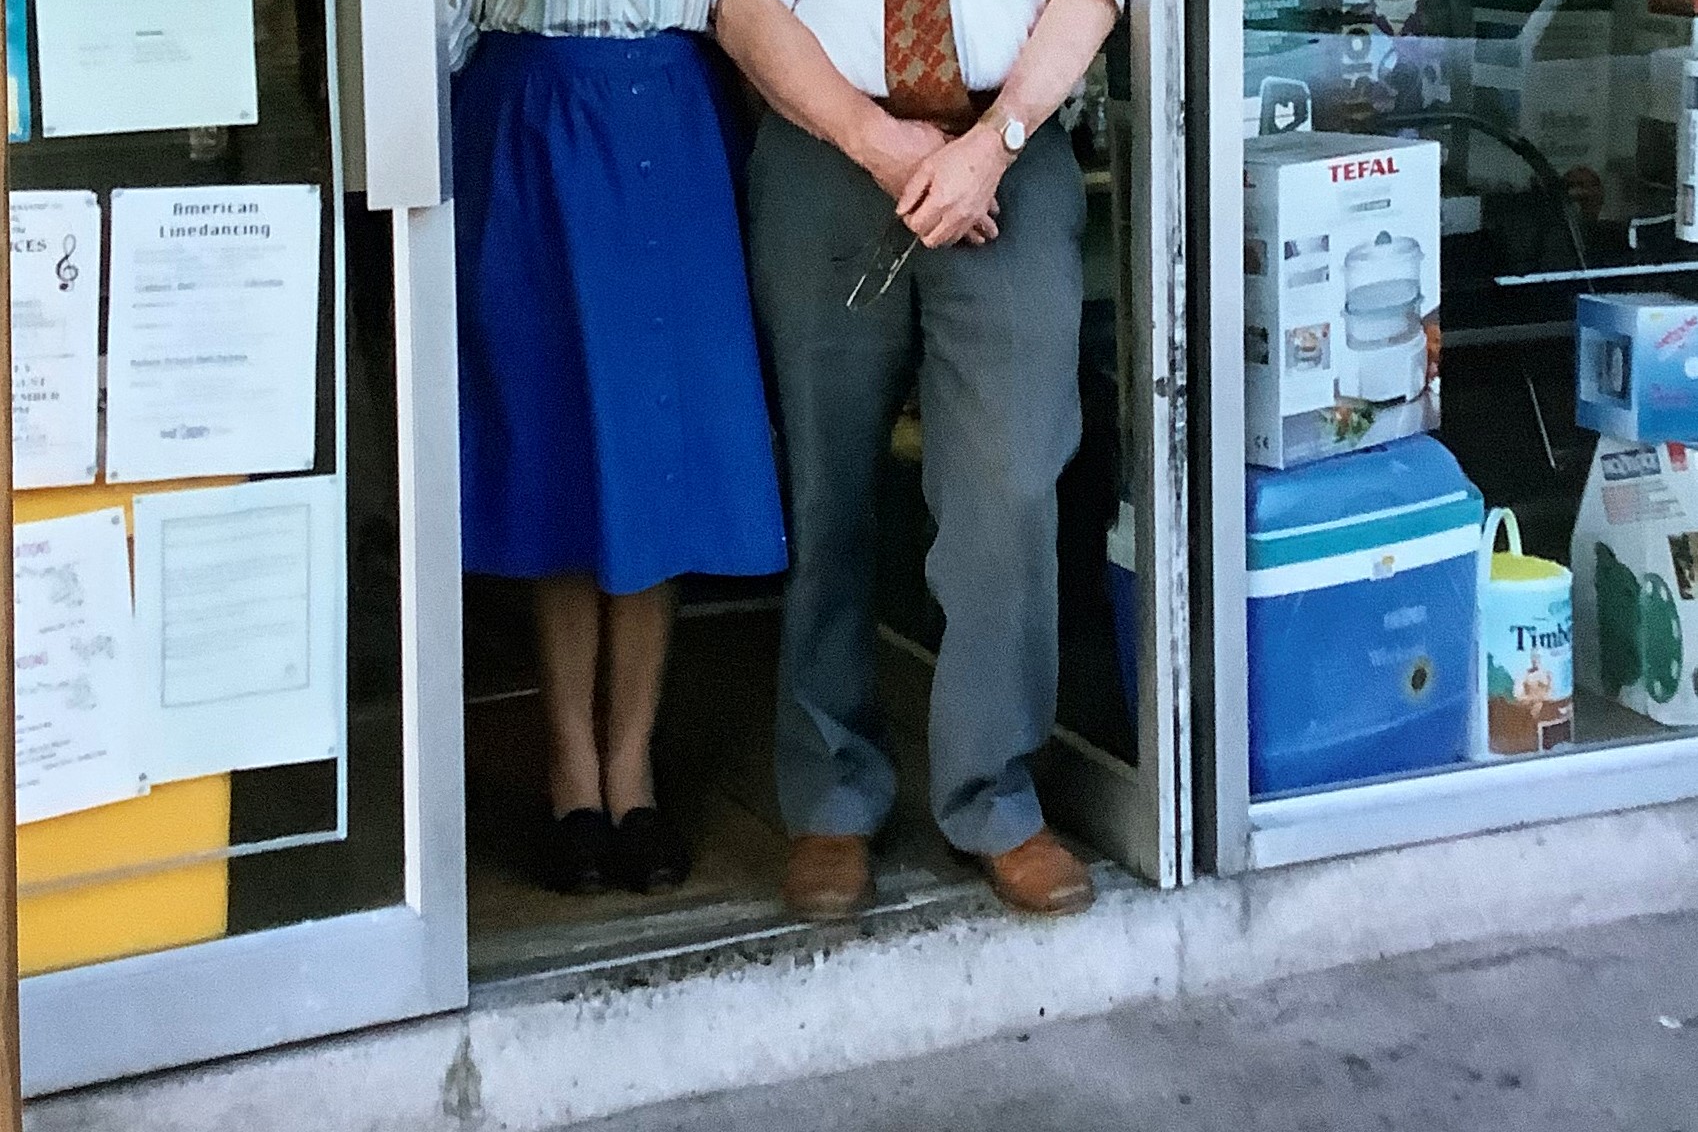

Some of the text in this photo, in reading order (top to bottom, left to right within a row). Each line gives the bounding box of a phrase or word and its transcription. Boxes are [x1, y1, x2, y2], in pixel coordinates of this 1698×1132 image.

[1328, 157, 1400, 183] TEFAL
[173, 201, 260, 216] American
[159, 223, 271, 239] Linedancing
